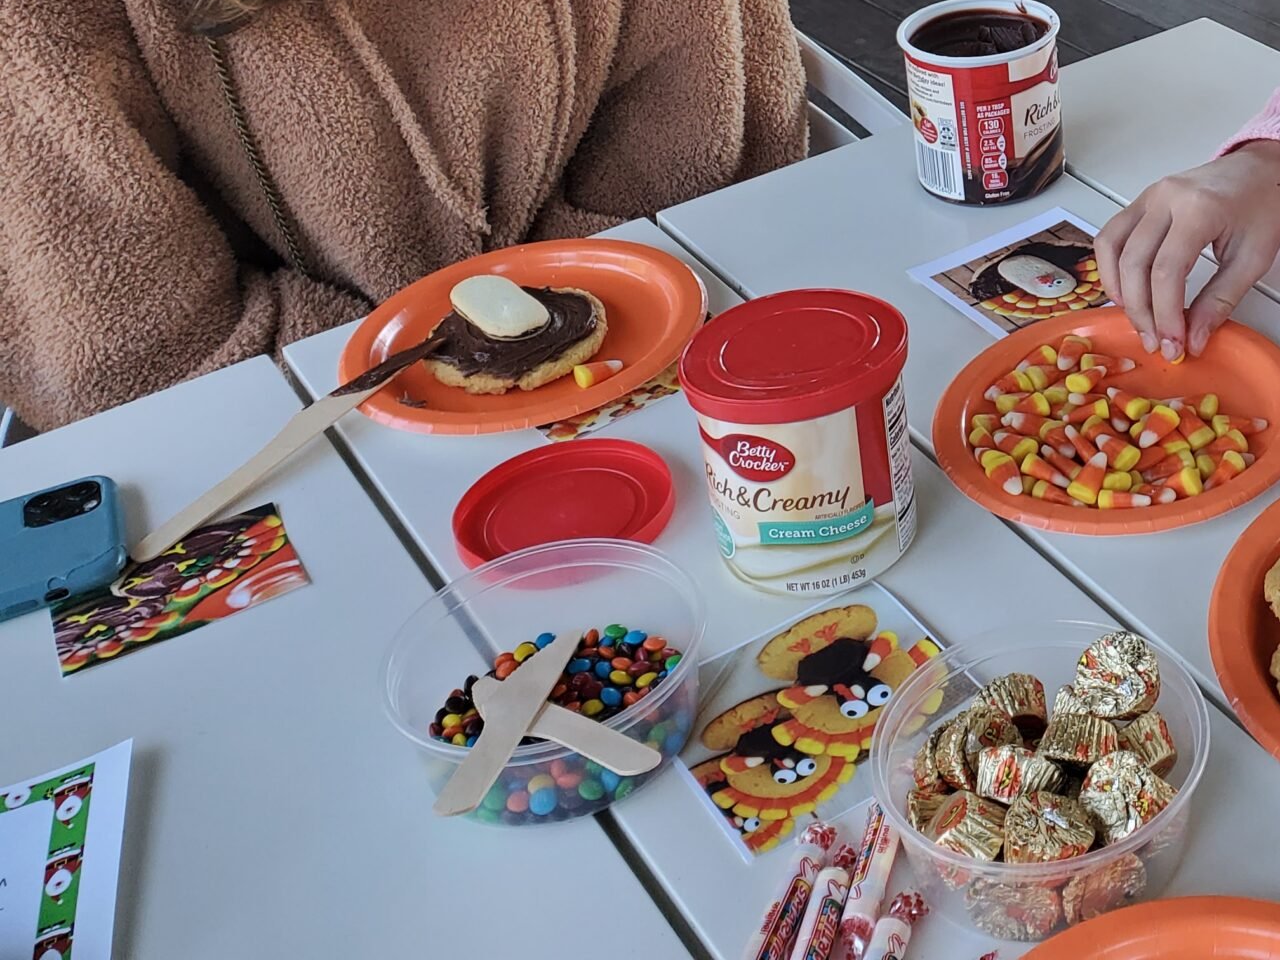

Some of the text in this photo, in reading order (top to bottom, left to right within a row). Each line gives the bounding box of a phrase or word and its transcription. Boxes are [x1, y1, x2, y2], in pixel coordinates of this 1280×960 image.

[983, 120, 999, 130] 130
[729, 451, 786, 472] Crocker
[736, 441, 777, 463] Betty
[768, 514, 868, 539] Cream Cheese
[786, 582, 799, 592] NET
[800, 581, 811, 591] WT
[812, 580, 821, 590] 16
[821, 579, 831, 589] OZ
[839, 574, 850, 587] LB)
[851, 568, 866, 582] 453g
